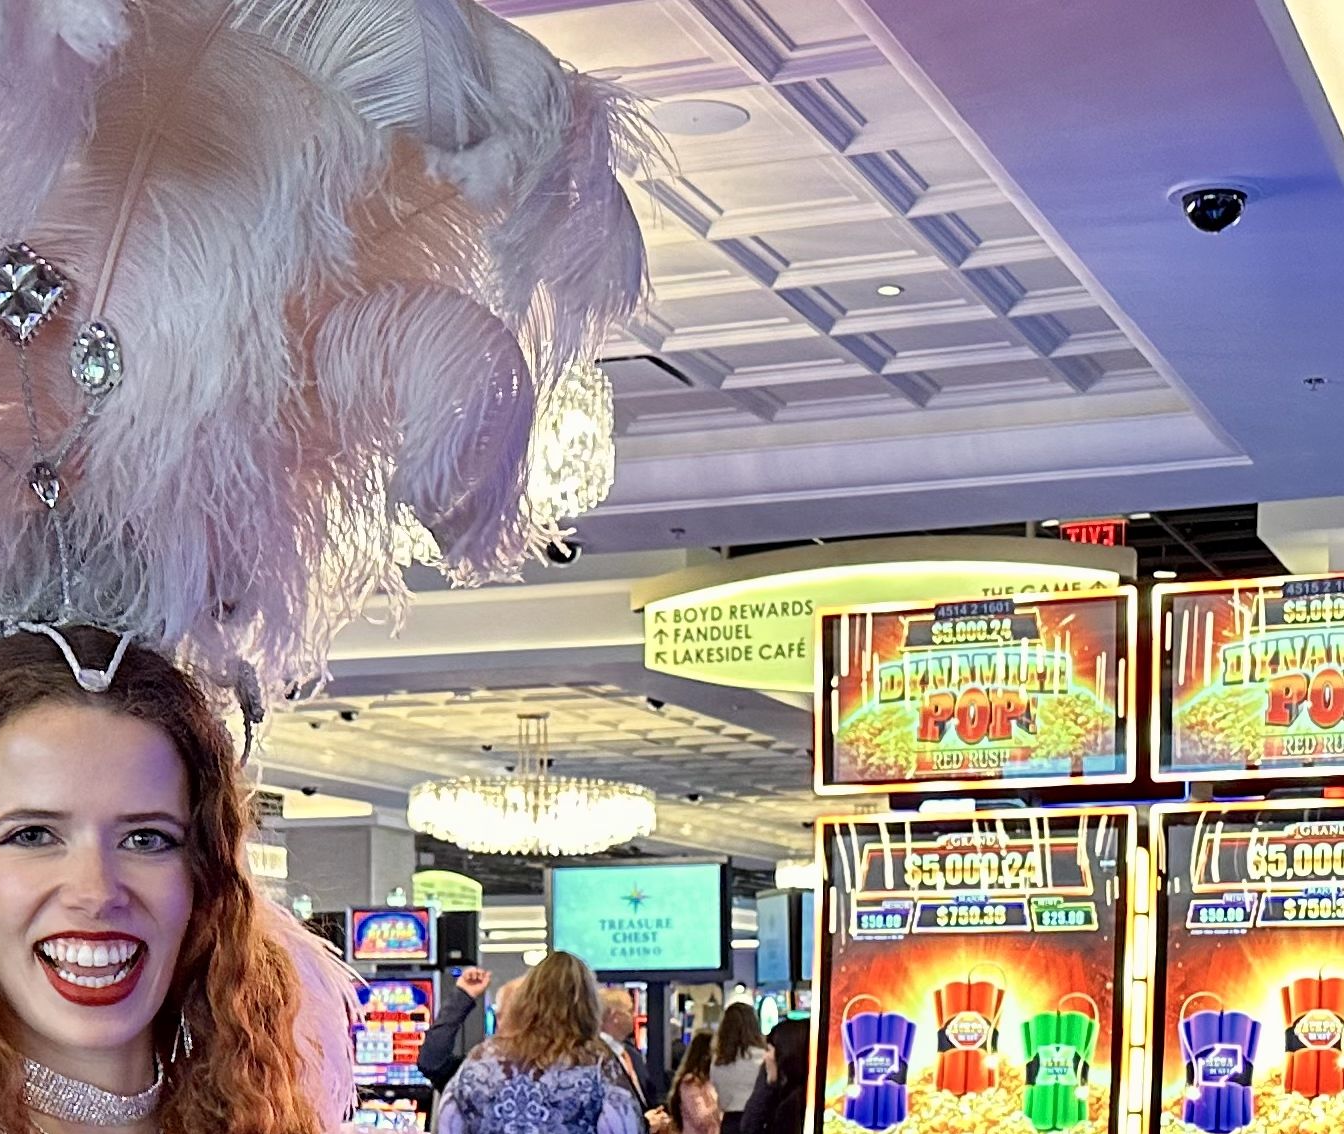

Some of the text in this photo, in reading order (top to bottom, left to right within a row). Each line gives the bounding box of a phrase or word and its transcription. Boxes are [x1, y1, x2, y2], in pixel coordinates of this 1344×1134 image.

[1320, 580, 1330, 593] 2
[673, 600, 813, 623] BOYD REWARDS
[970, 603, 979, 615] 2
[674, 624, 752, 644] FANDUEL
[673, 637, 806, 665] LAKESIDE CAFÉ
[917, 687, 1038, 745] POP!
[1282, 736, 1316, 756] RED
[932, 749, 1011, 770] RED RUSH
[599, 918, 672, 931] TREASURE
[612, 931, 658, 943] CHEST
